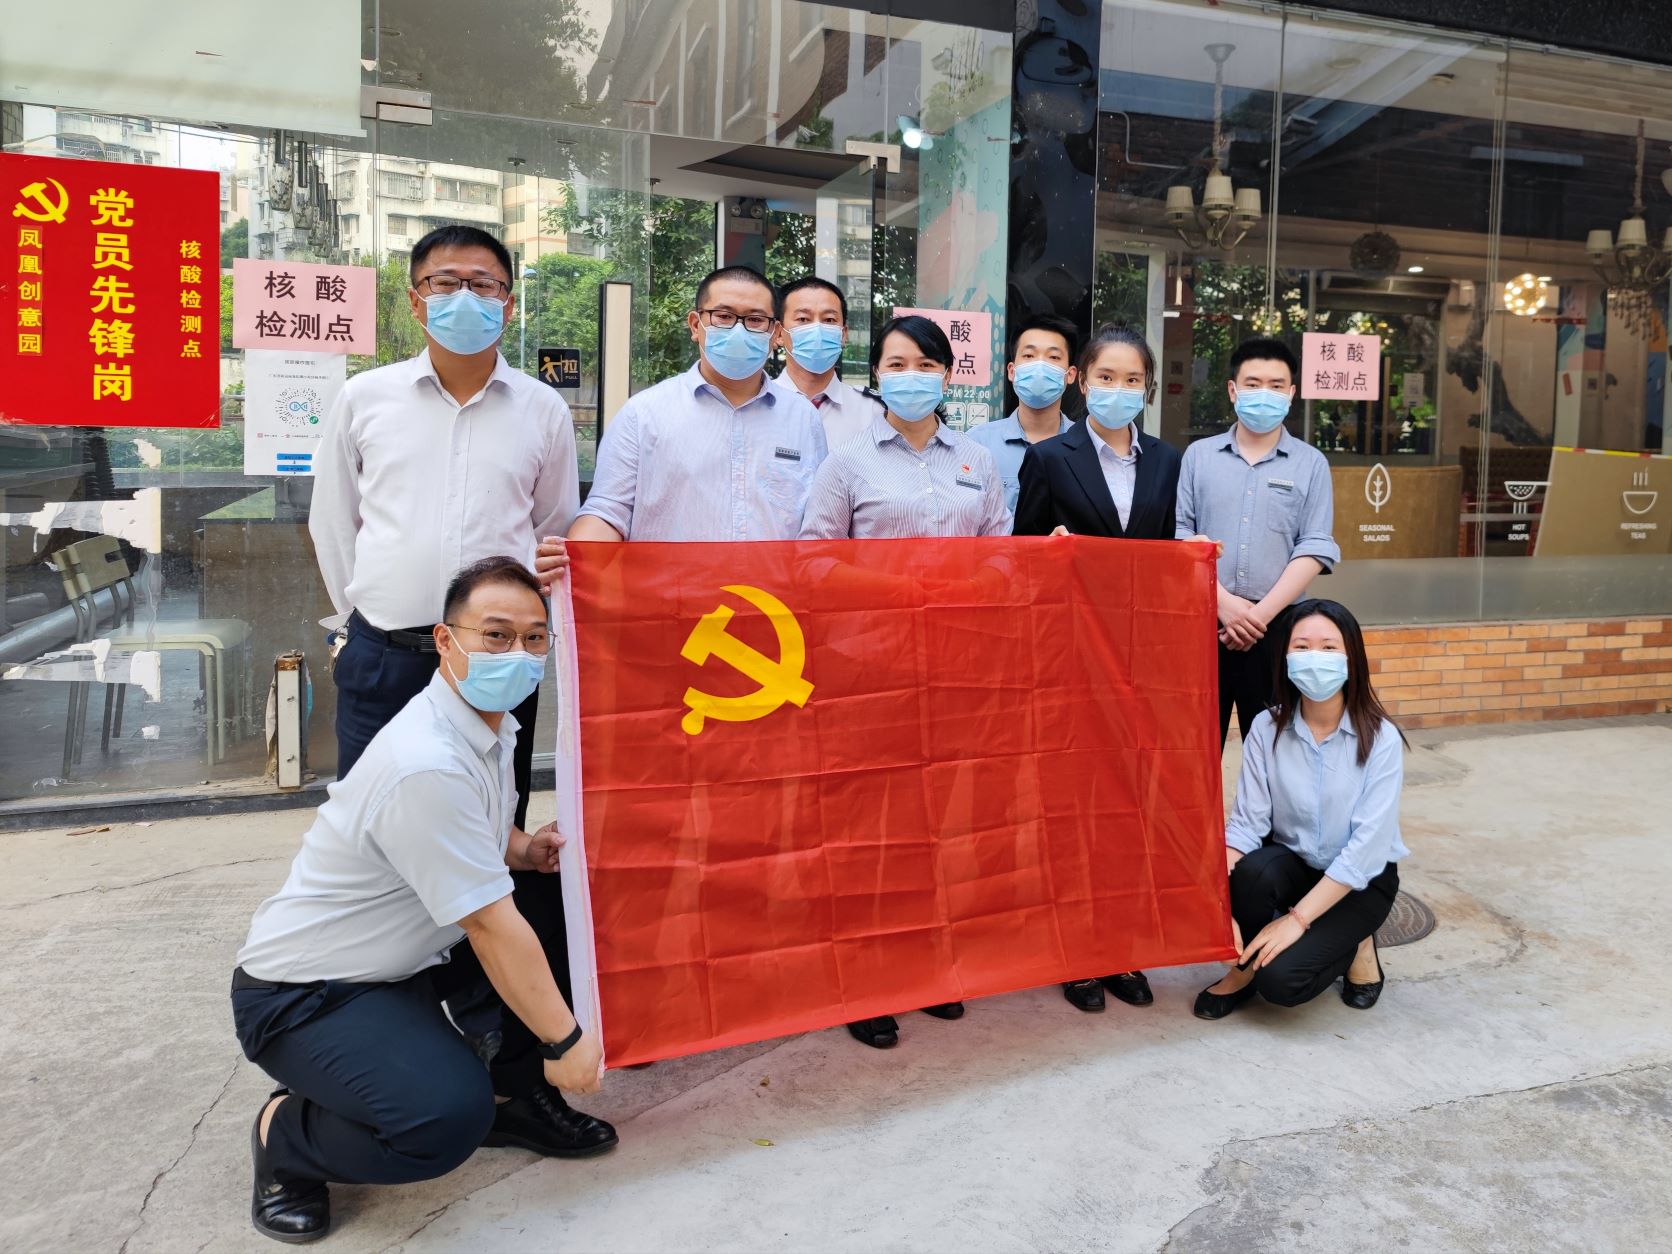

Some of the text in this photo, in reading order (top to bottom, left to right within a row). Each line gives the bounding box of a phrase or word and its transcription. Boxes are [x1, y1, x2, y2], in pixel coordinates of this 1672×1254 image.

[18, 228, 43, 354] 凤凰创意园
[89, 187, 136, 402] 党员先锋岗
[264, 270, 348, 304] 核酸
[180, 240, 202, 358] 核酸检测点
[255, 310, 355, 343] 检测点
[950, 319, 972, 343] 酸
[1319, 340, 1366, 364] 核酸
[561, 359, 579, 374] 拉
[956, 352, 976, 375] 点
[1313, 371, 1369, 393] 检测点
[963, 389, 990, 399] 22:00
[1359, 524, 1395, 532] SEASONAL
[1363, 534, 1391, 542] SALADS
[1508, 533, 1530, 541] SOUPS
[1512, 523, 1526, 531] HOT
[1630, 532, 1647, 540] TEAS
